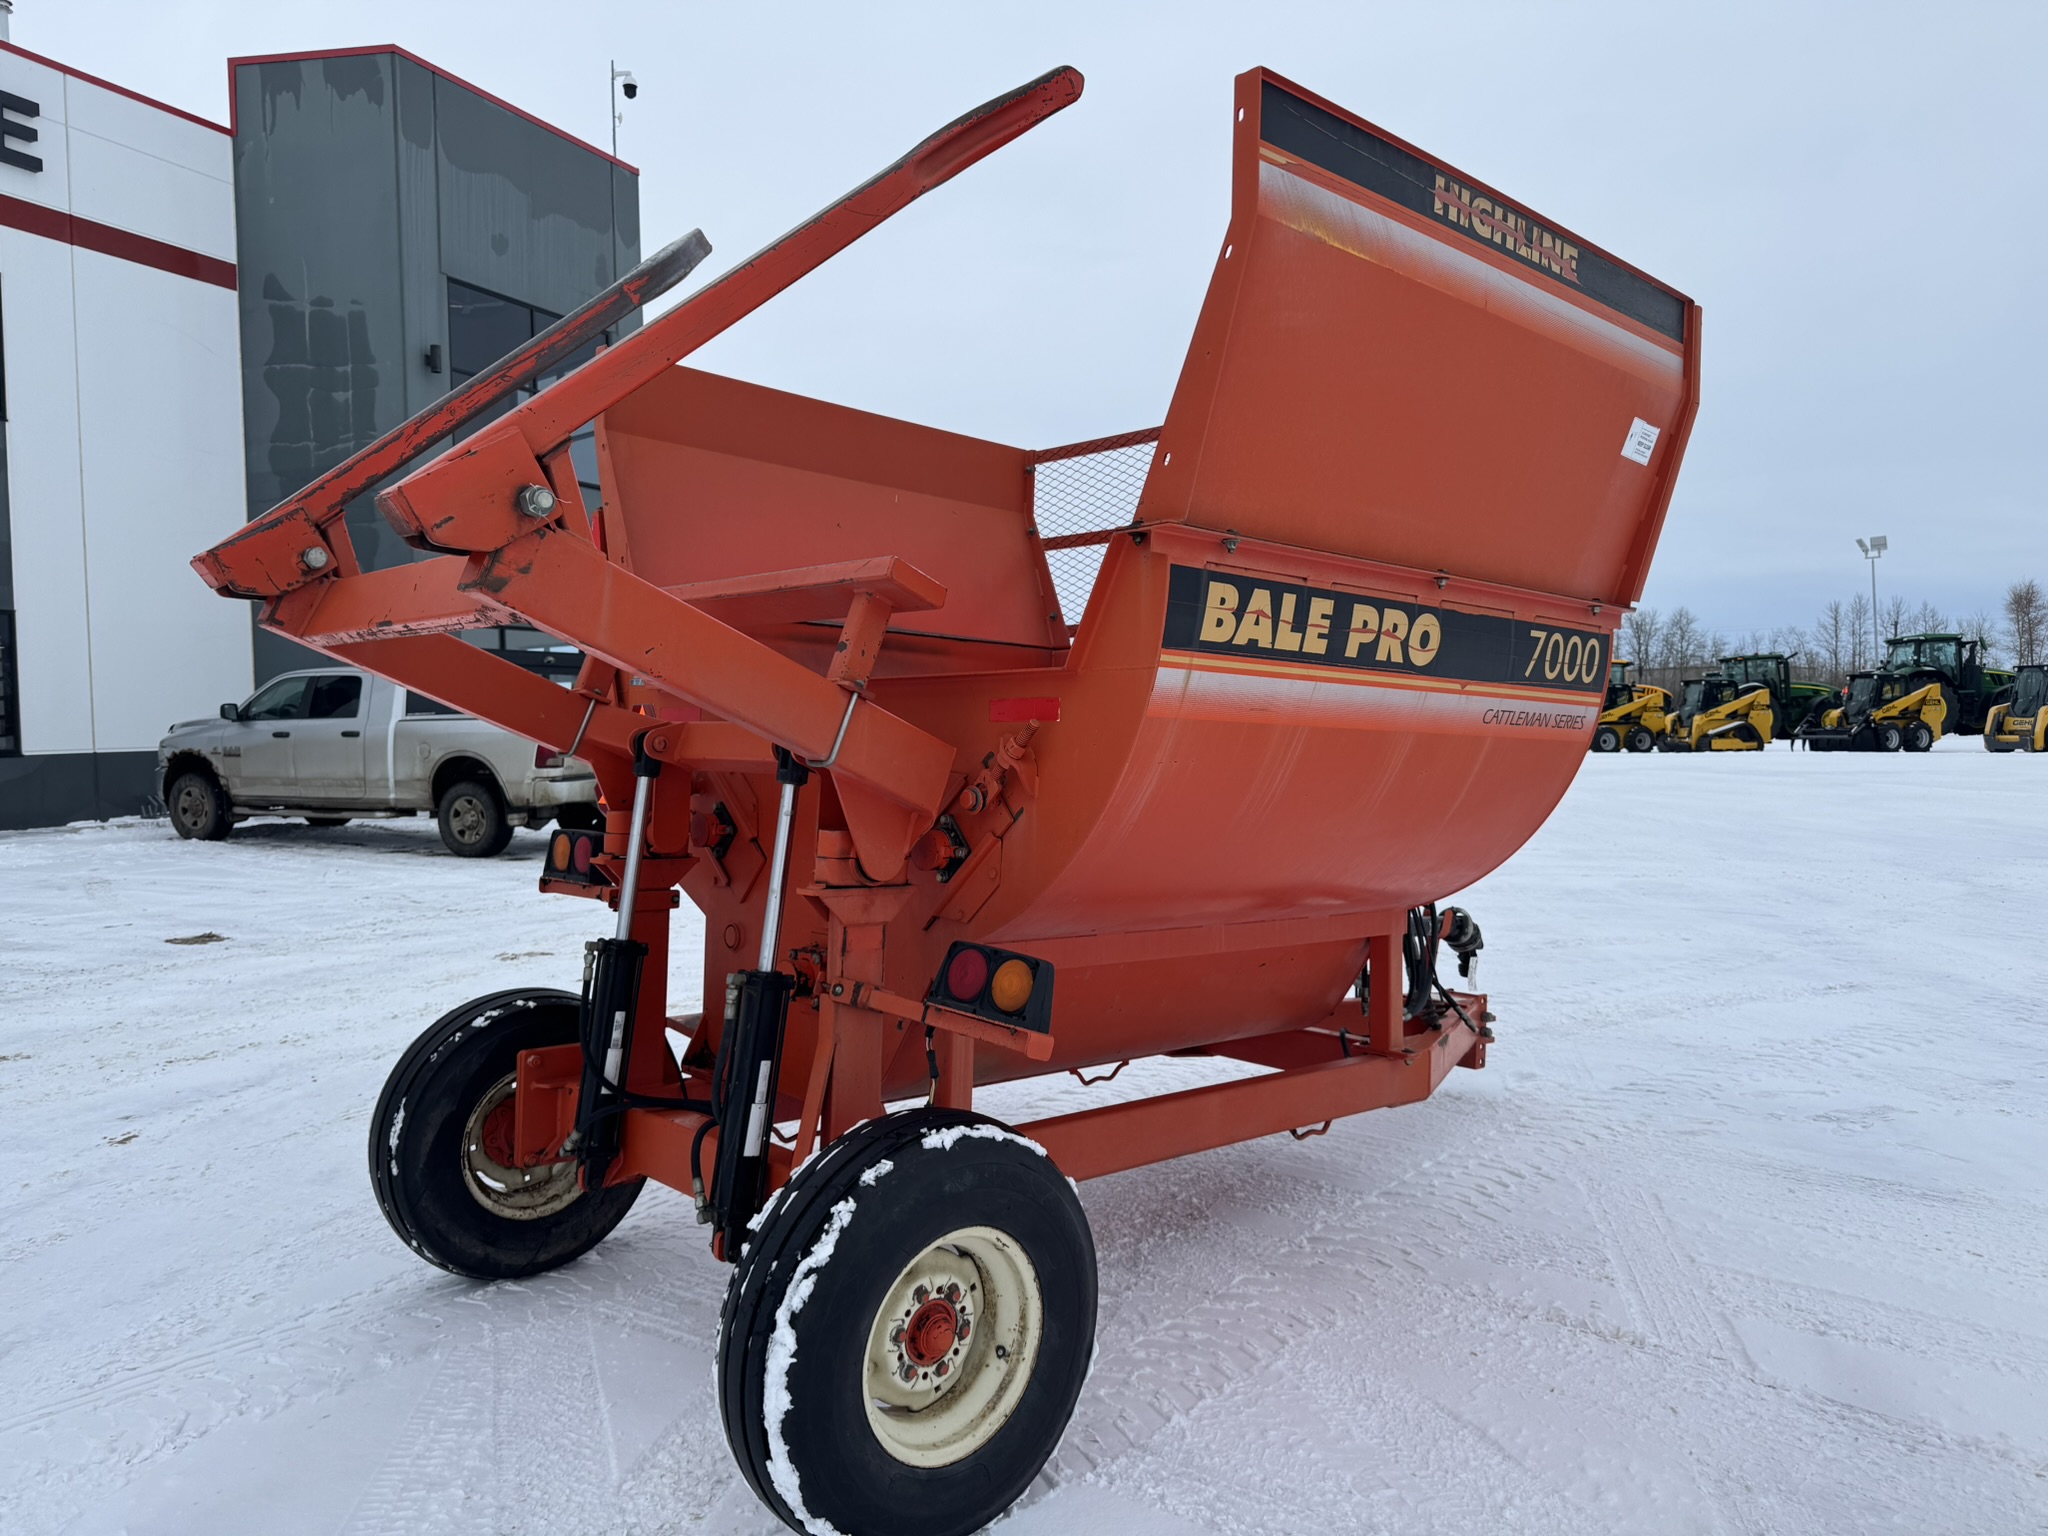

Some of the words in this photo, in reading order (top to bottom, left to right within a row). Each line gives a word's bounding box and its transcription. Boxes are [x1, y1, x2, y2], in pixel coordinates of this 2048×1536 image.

[1433, 174, 1580, 281] HIGHLINE
[1199, 581, 1334, 655] BALE
[1345, 603, 1441, 667] PRO
[1524, 629, 1600, 684] 7000
[1482, 708, 1551, 728] CATTLEMAN
[1551, 713, 1587, 730] SERIES
